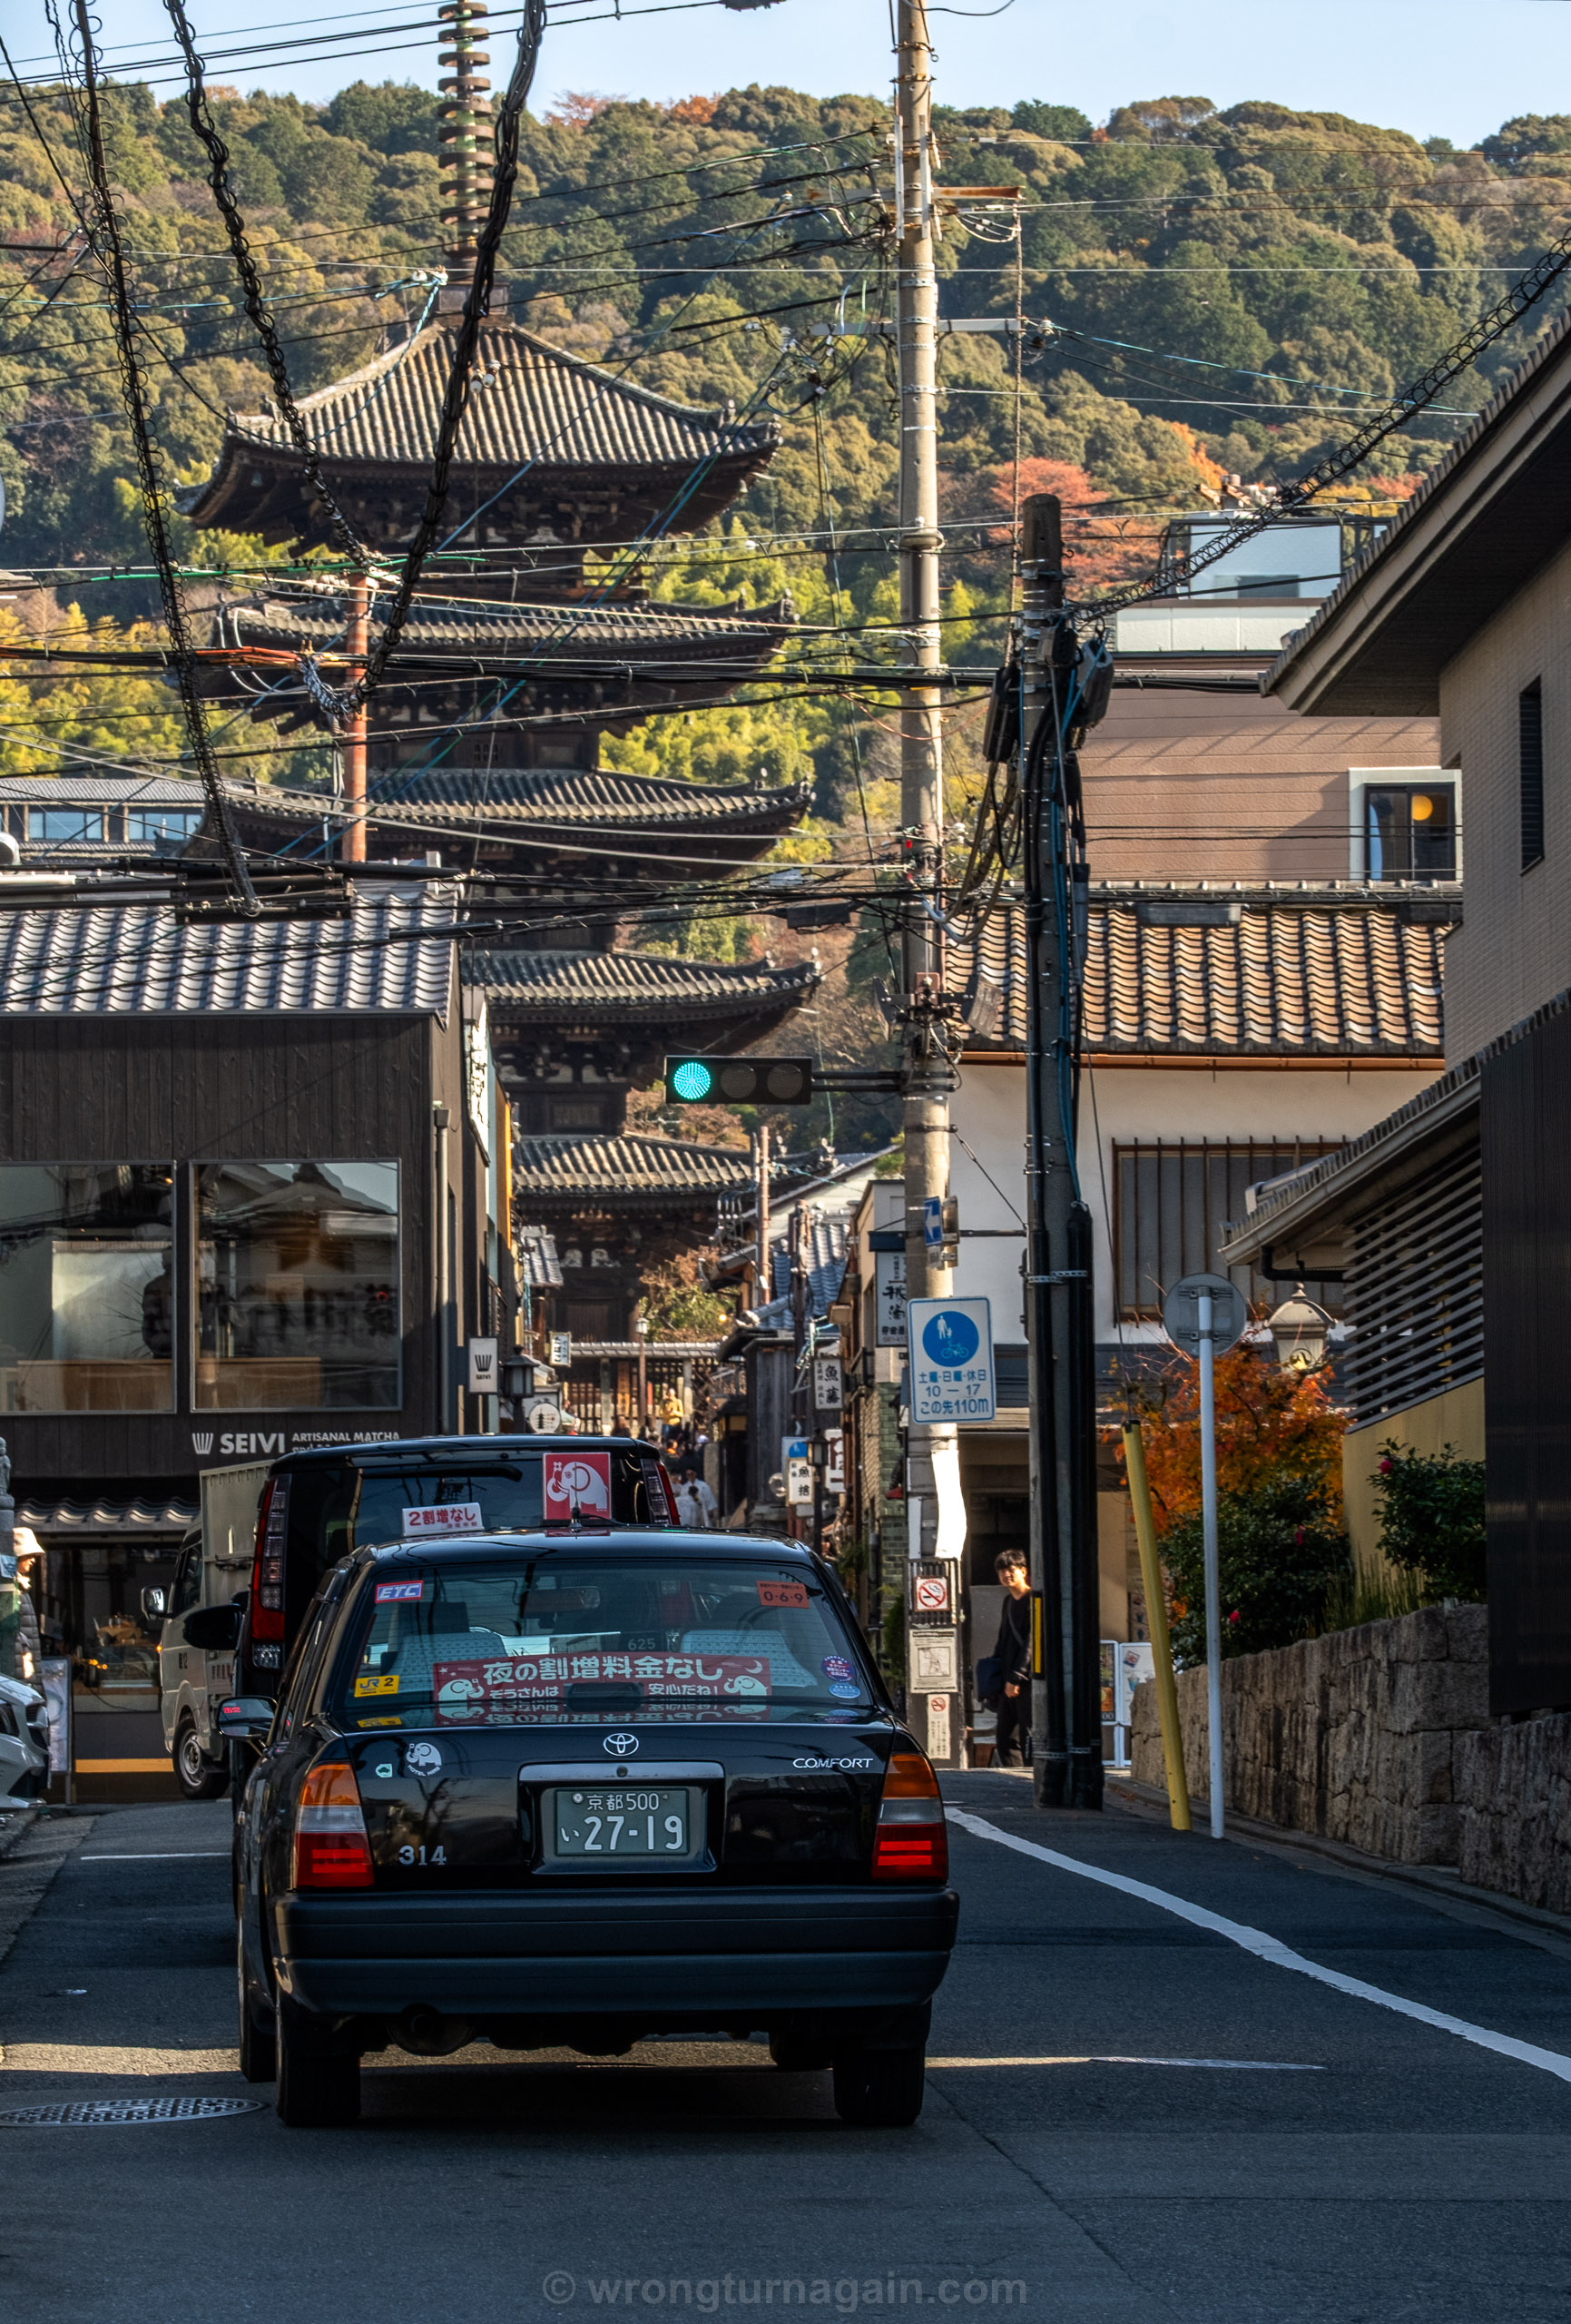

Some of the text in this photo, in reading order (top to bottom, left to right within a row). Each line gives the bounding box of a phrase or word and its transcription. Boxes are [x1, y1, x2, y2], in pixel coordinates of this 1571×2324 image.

[926, 1385, 941, 1398] 10
[966, 1384, 981, 1396] 17
[220, 1432, 400, 1454] SEIVI ARTISANAL MATCHA
[408, 1507, 476, 1526] 2割増なし
[378, 1584, 420, 1599] ETC
[627, 1638, 655, 1650] 625
[483, 1655, 723, 1686] 夜の割増料金なし
[359, 1677, 394, 1689] JR 2
[648, 1682, 718, 1696] 安心だね!
[489, 1686, 559, 1699] ぞうさんは
[792, 1758, 874, 1768] COMFORT
[584, 1815, 682, 1851] 27-19
[398, 1845, 447, 1866] 314
